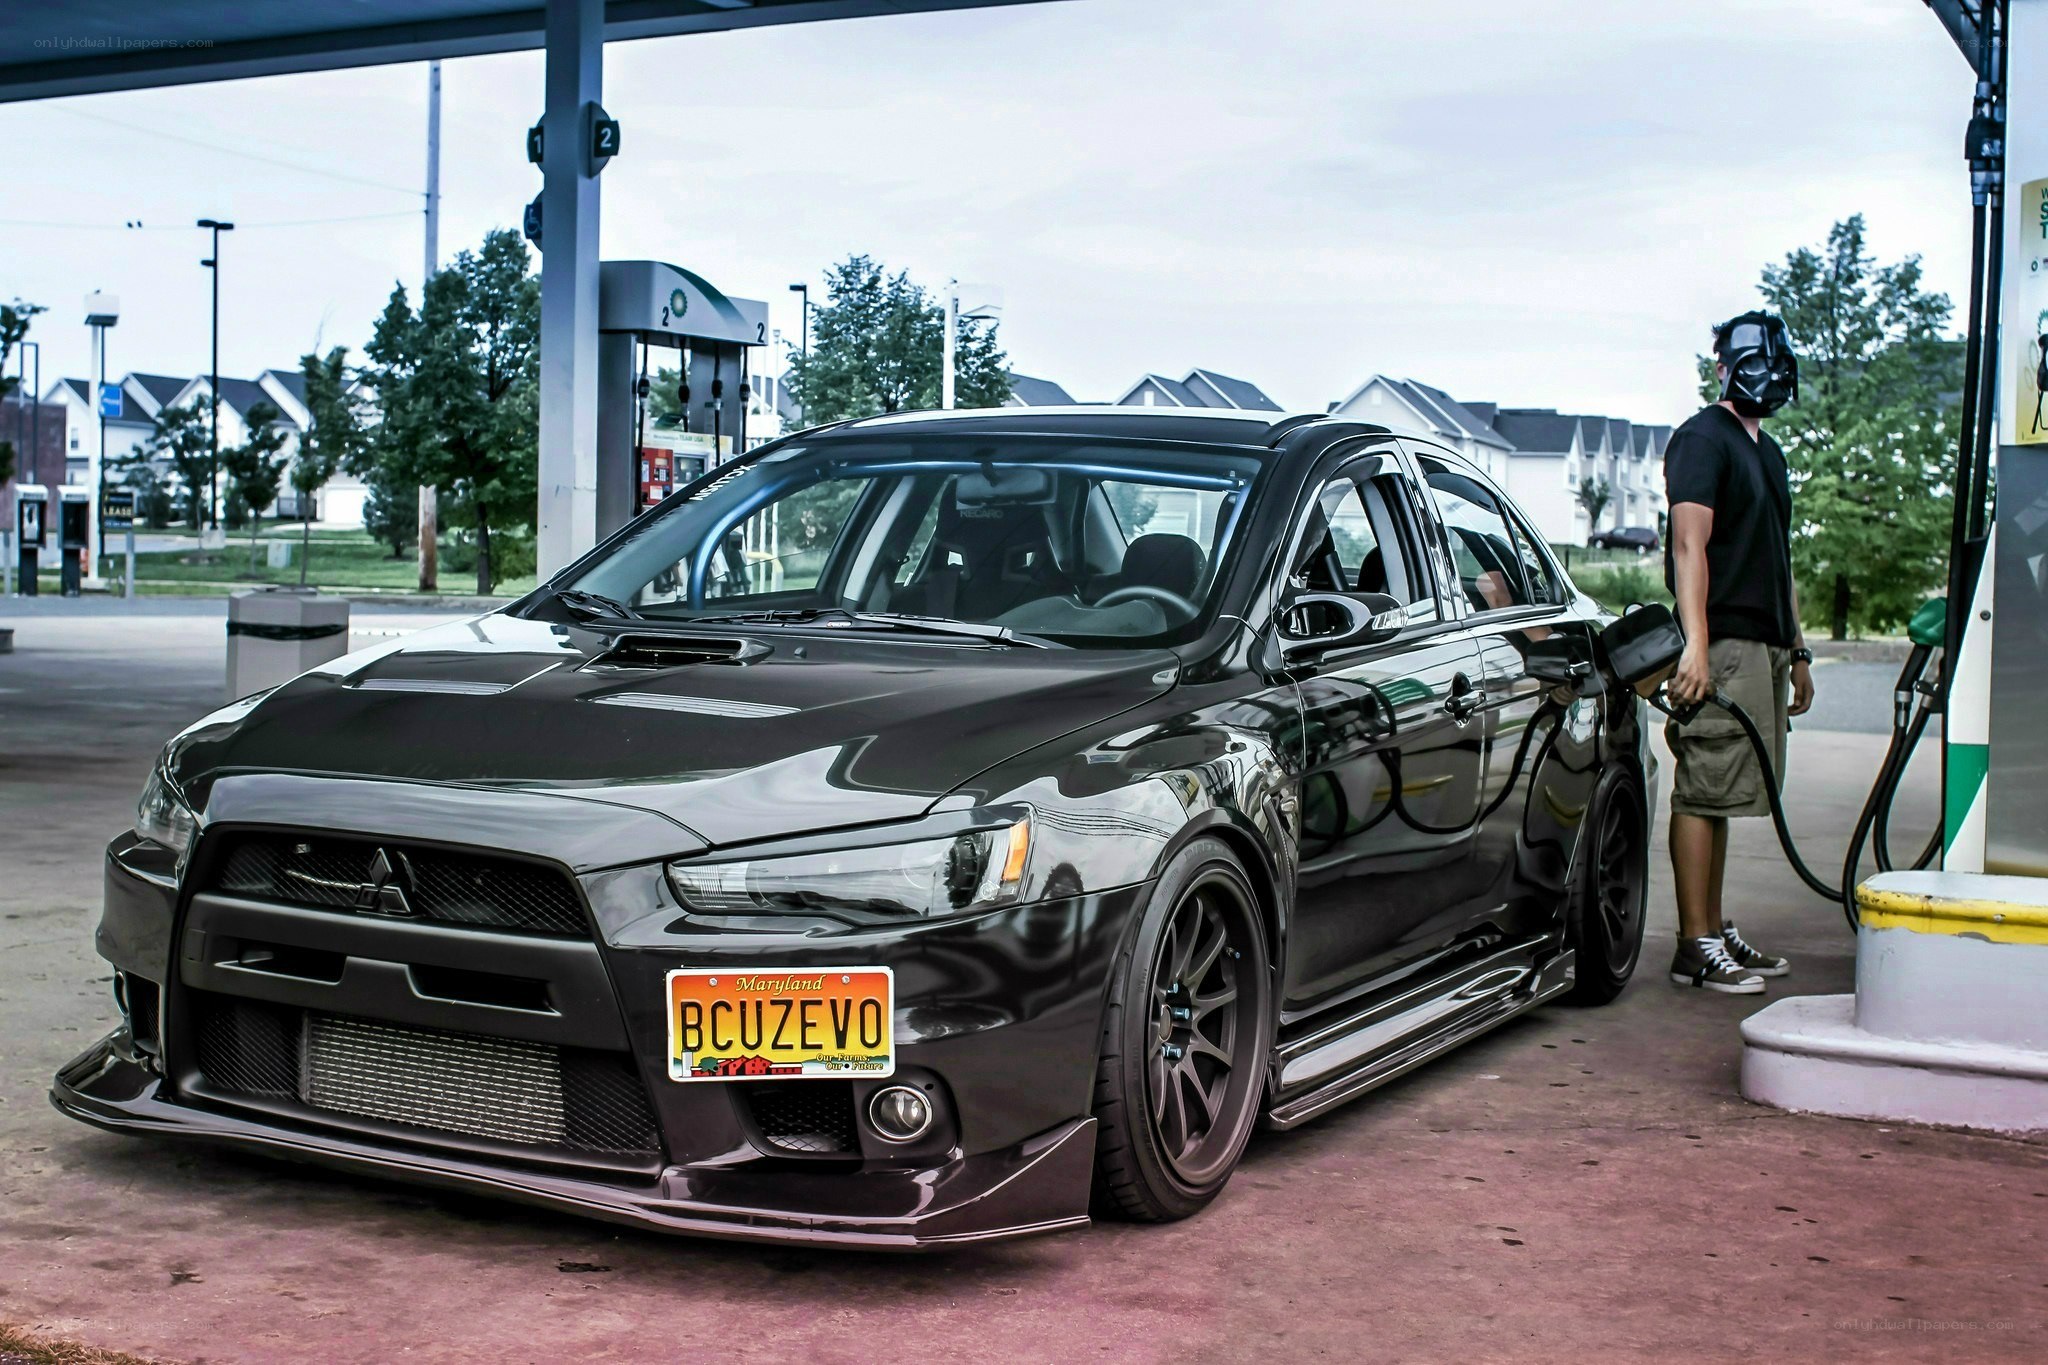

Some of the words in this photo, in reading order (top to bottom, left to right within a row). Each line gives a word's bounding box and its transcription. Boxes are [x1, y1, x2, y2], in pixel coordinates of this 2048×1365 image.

[534, 134, 542, 154] 1
[600, 127, 612, 148] 2
[662, 306, 669, 327] 2
[757, 322, 765, 343] 2
[735, 974, 827, 995] Maryland
[681, 997, 882, 1052] BCUZEVO
[816, 1053, 833, 1062] Our
[826, 1061, 843, 1070] Our
[852, 1062, 883, 1070] Future
